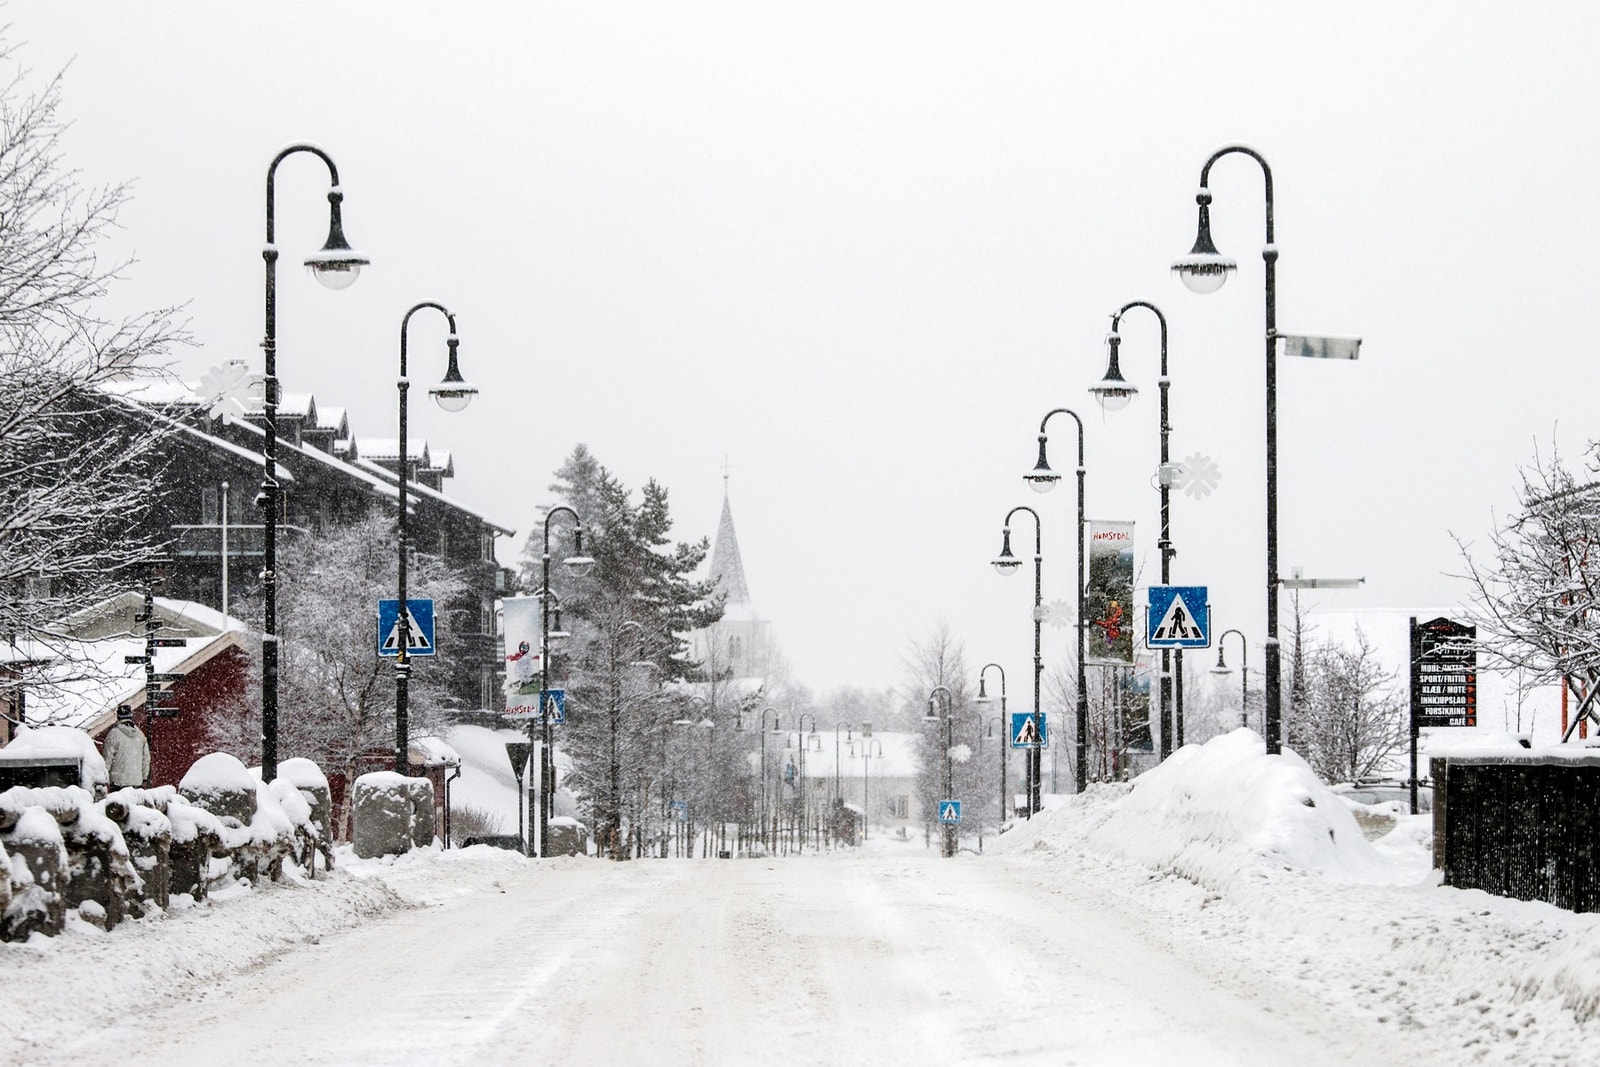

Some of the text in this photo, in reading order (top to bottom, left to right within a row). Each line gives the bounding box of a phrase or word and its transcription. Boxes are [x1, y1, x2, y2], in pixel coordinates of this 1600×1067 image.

[1419, 674, 1466, 683] SPORT/FRITID
[1422, 685, 1441, 693] KLÆR
[1447, 685, 1466, 693] MOTE
[1425, 707, 1466, 715] FORSIKRING
